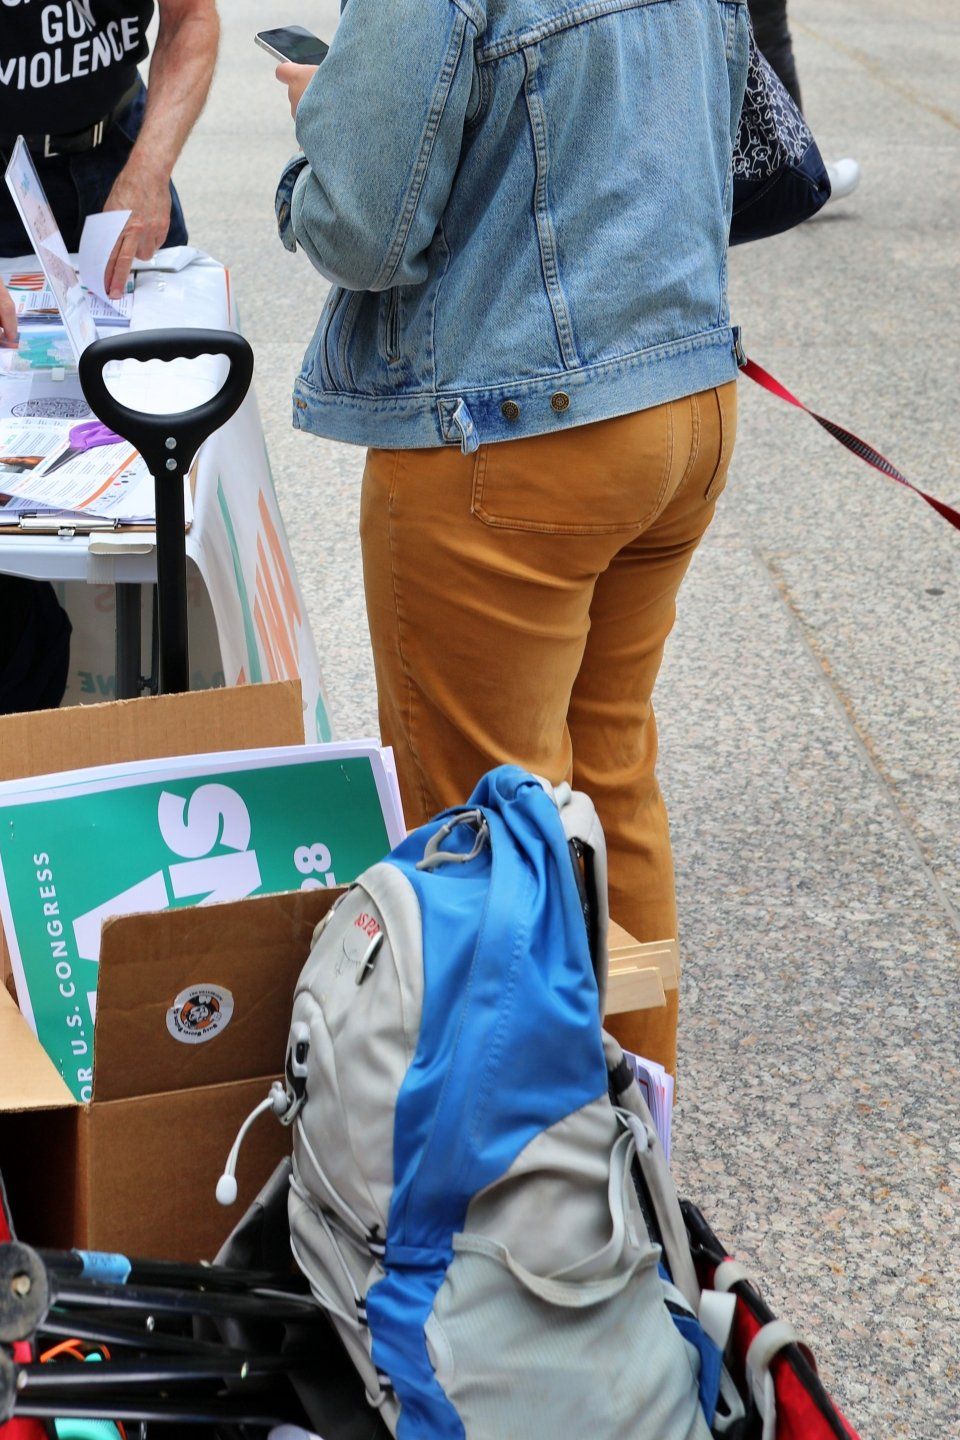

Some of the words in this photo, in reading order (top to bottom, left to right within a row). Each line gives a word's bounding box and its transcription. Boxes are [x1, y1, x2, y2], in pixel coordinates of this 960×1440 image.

[34, 852, 76, 998] CONGRESS
[66, 1006, 88, 1056] U.S.
[78, 1066, 94, 1104] OR
